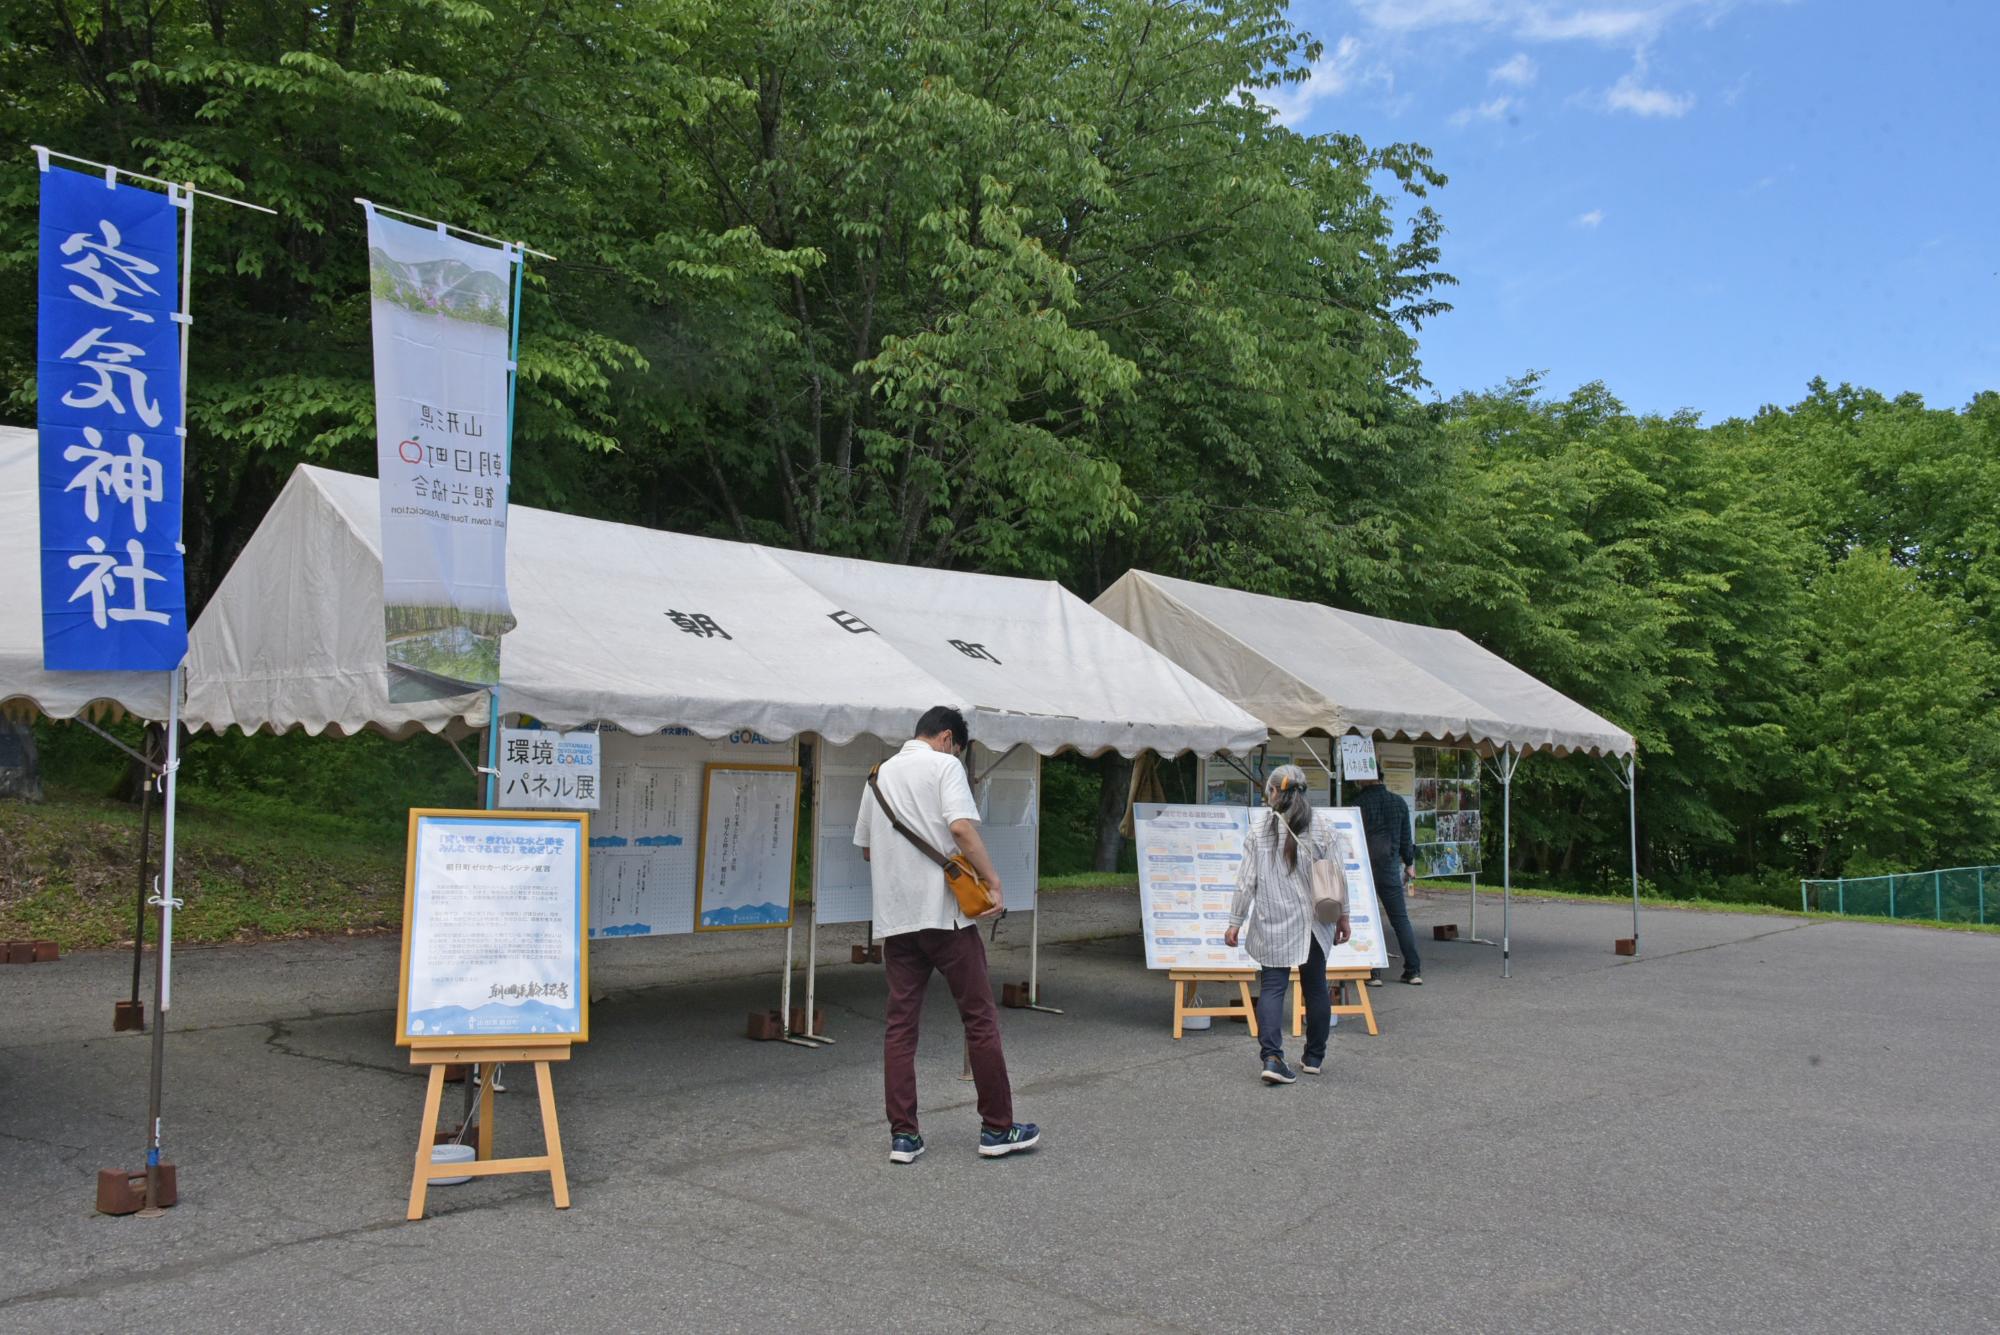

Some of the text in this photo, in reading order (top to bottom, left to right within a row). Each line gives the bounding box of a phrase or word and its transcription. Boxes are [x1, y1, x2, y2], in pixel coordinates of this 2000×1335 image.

[59, 219, 172, 631] 空気神社
[507, 739, 553, 765] 環境
[557, 754, 593, 765] GOALS
[506, 772, 595, 800] パネル展
